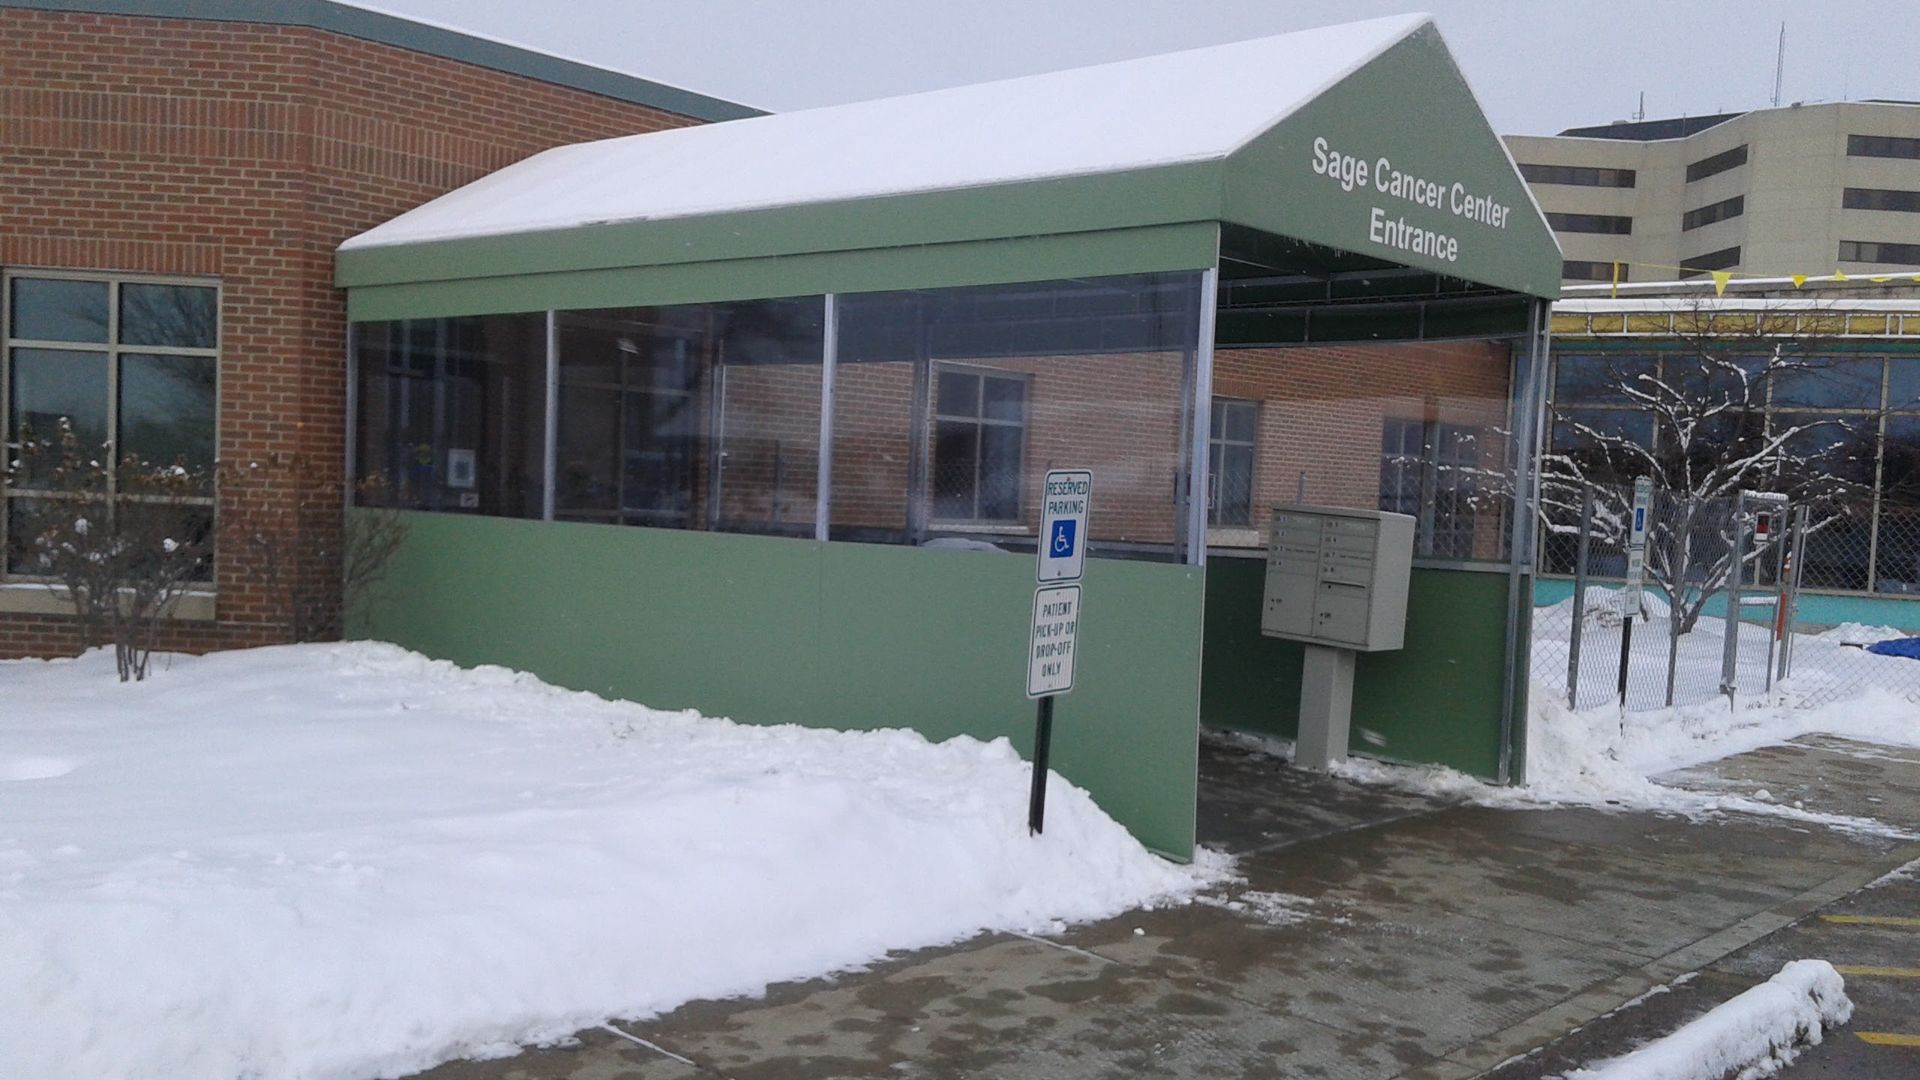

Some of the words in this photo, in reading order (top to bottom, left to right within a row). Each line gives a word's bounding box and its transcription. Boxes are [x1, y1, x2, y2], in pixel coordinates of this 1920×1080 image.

[1312, 136, 1369, 192] Sage
[1375, 157, 1447, 210] Cancer
[1450, 182, 1510, 229] Center
[1369, 207, 1458, 262] Entrance
[1047, 481, 1088, 497] RESERVED
[1048, 500, 1084, 515] PARKING
[1042, 602, 1072, 618] PATIENT
[1035, 622, 1064, 639] PICK-UP
[1065, 620, 1075, 635] OR
[1036, 641, 1072, 659] DROP-OFF
[1041, 661, 1061, 678] ONLY
